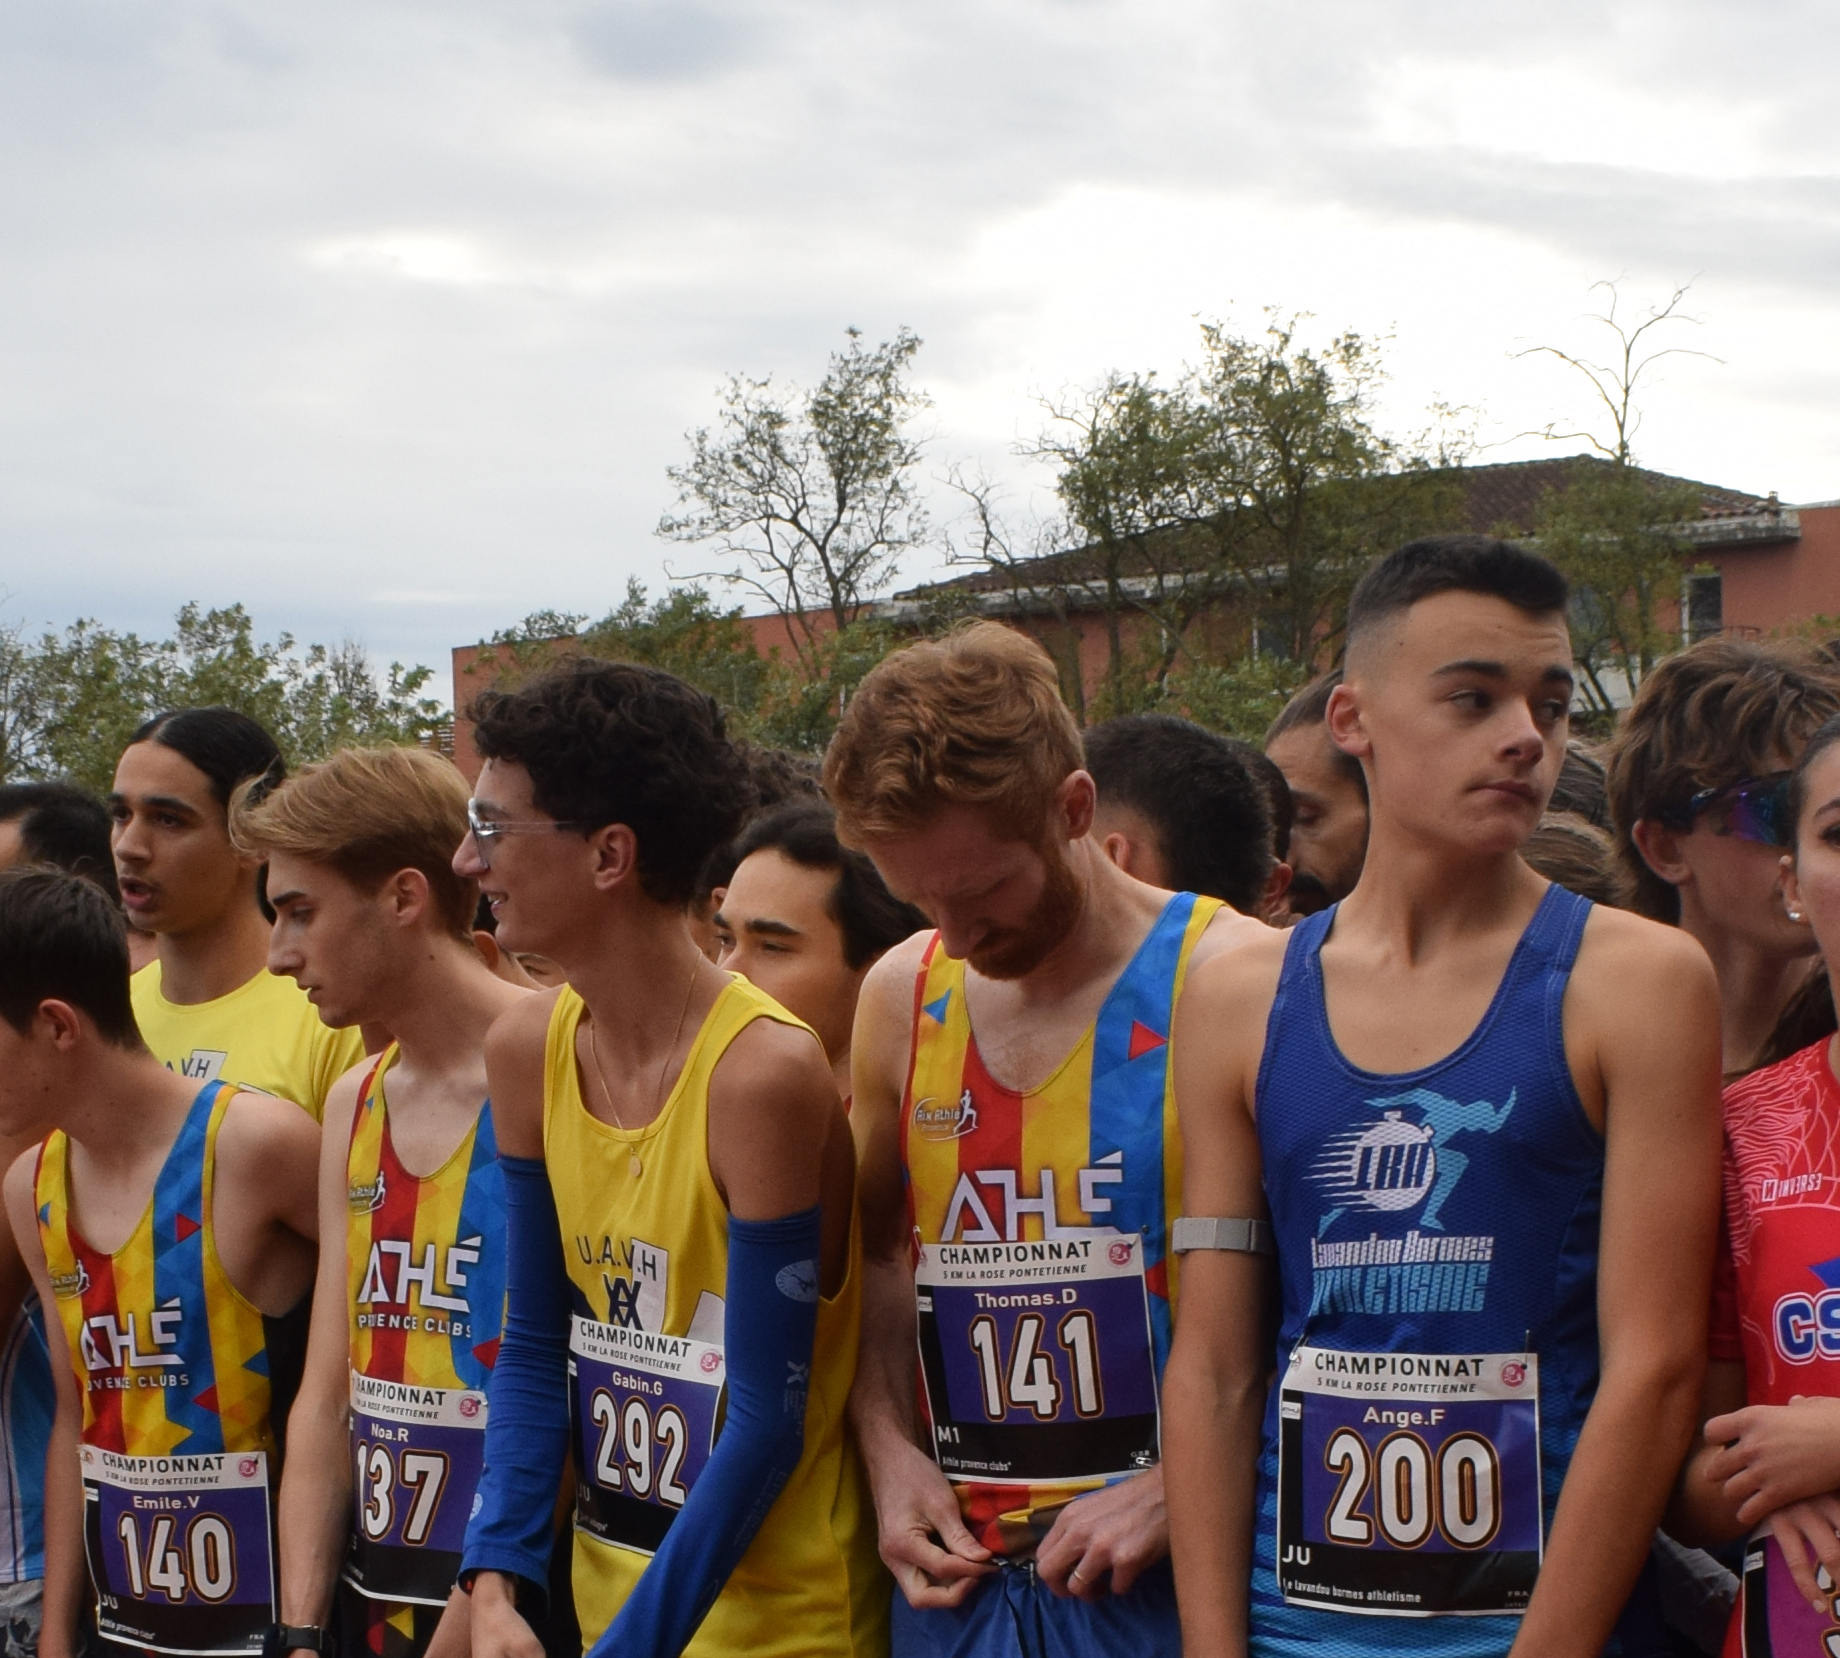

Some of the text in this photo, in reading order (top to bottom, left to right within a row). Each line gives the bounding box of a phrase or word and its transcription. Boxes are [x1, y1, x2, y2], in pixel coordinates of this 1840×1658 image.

[576, 1235, 657, 1282] U.A.V.H
[939, 1241, 1092, 1265] CHAMPIONNAT
[966, 1270, 977, 1280] LA
[980, 1269, 1005, 1279] ROSE
[1009, 1264, 1087, 1278] PONTETIENNE
[974, 1288, 1077, 1308] Thomas.D
[580, 1321, 692, 1358] CHAMPIONNAT
[599, 1346, 608, 1355] LA
[611, 1349, 628, 1361] ROSE
[1315, 1352, 1485, 1377] CHAMPIONNAT
[972, 1315, 1098, 1417] 141
[138, 1374, 189, 1388] CLUBS
[612, 1371, 663, 1396] Gabin.G
[1316, 1377, 1476, 1394] 5 KM LA ROSE PONTETIENNE
[1362, 1406, 1446, 1429] Ange.F
[371, 1423, 409, 1443] Noa.R
[592, 1392, 687, 1505] 292
[102, 1452, 225, 1473] CHAMPIONNAT
[152, 1476, 220, 1486] PONTETIENNE
[1328, 1433, 1497, 1544] 200
[132, 1495, 201, 1509] Emile.V
[120, 1515, 233, 1600] 140
[1282, 1545, 1311, 1566] JU
